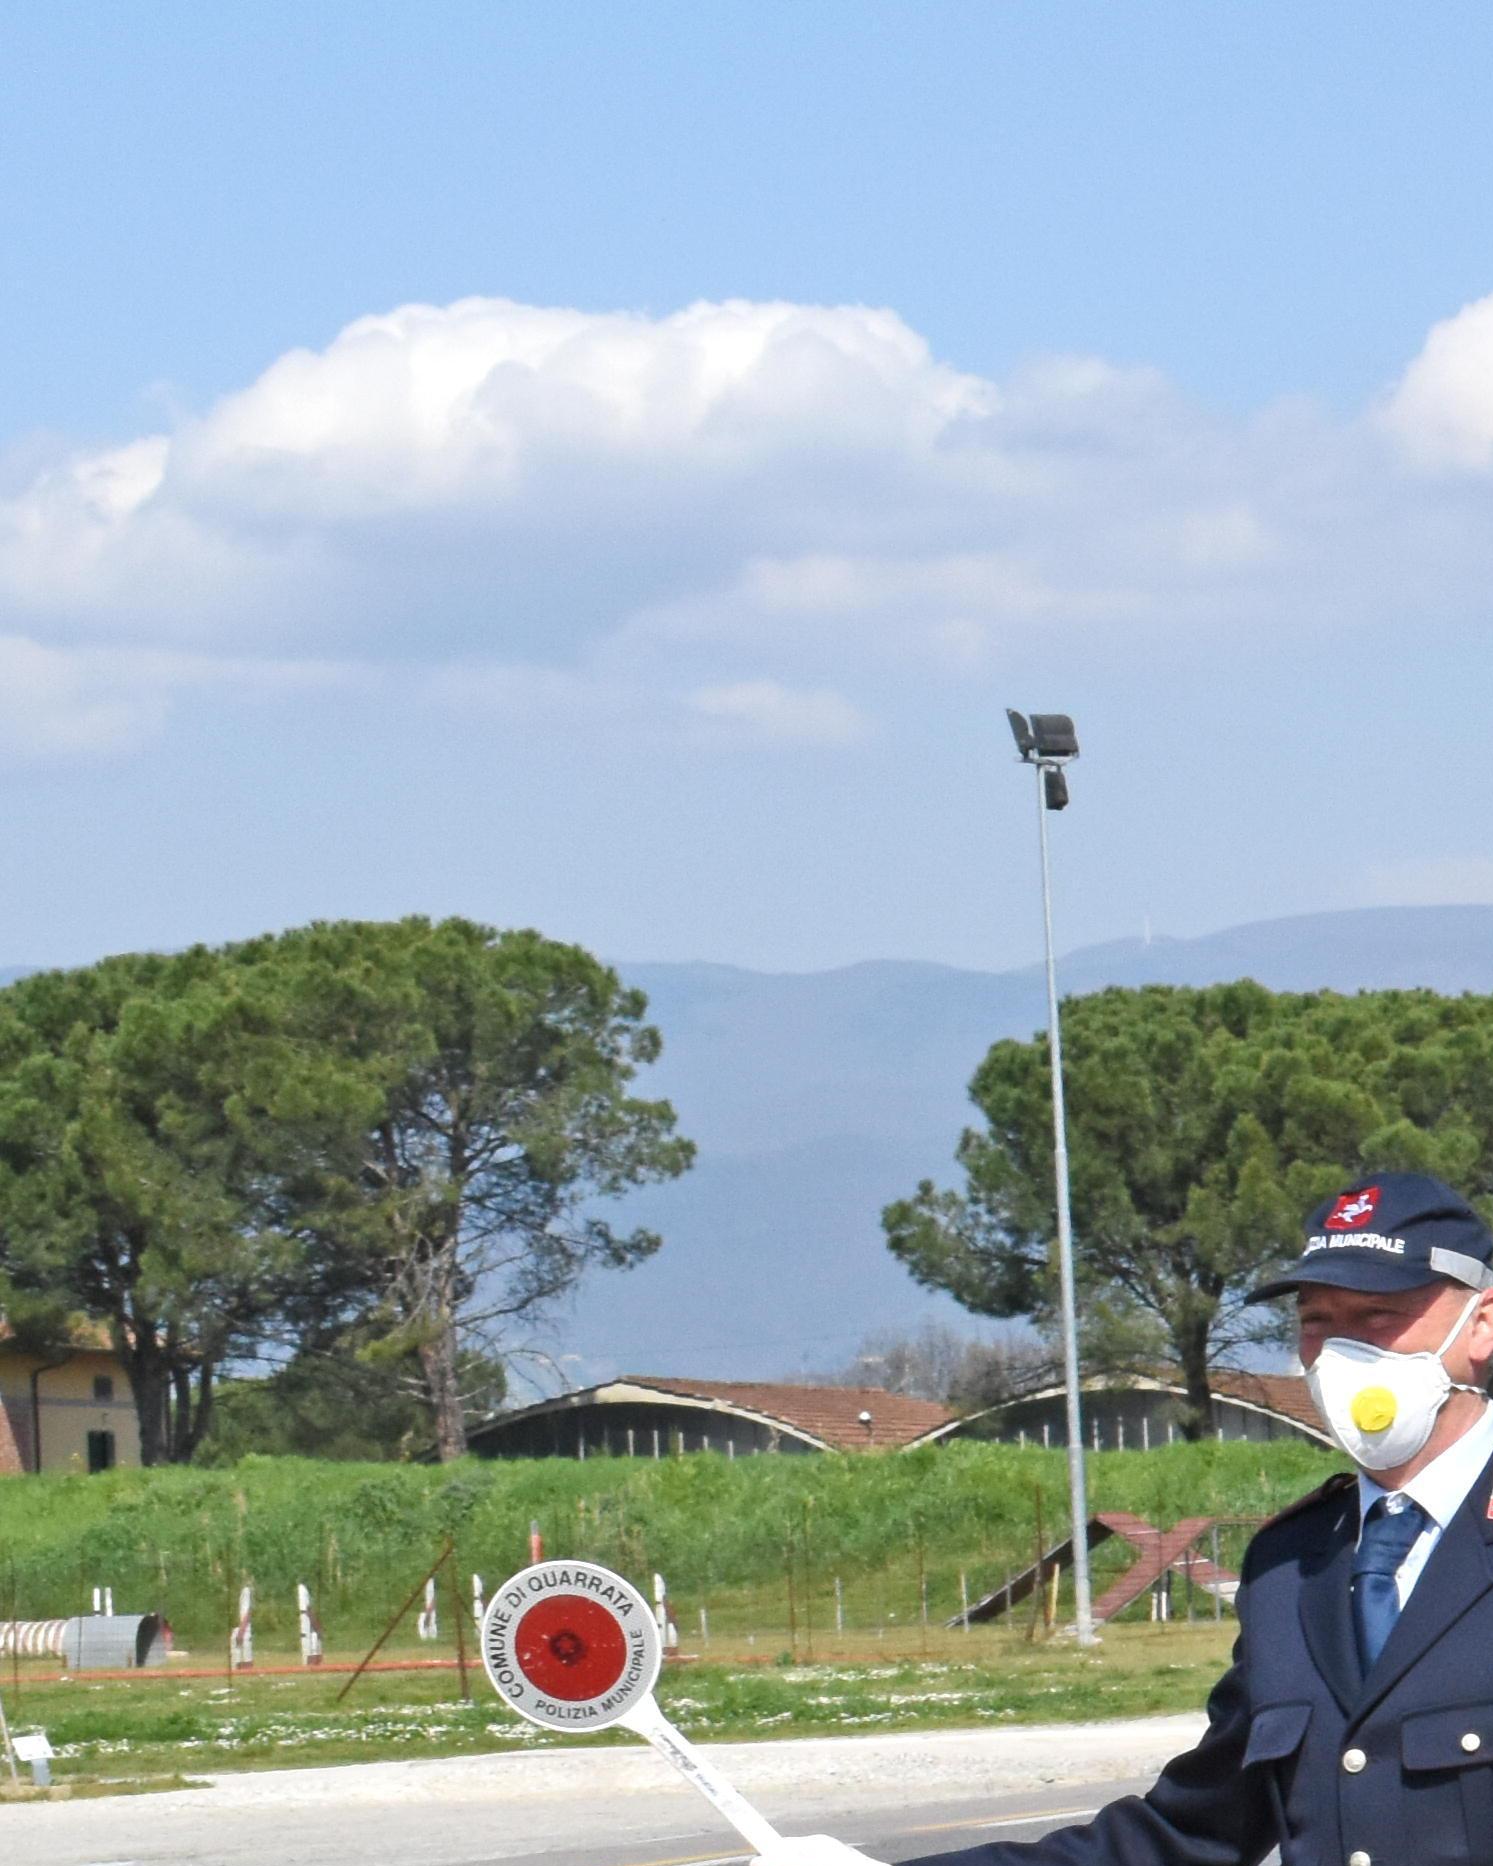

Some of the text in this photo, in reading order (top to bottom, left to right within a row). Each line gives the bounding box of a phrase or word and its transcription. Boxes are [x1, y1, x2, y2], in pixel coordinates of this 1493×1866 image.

[1329, 1233, 1406, 1254] MUNICIPALE
[487, 1571, 635, 1700] COMUNE DI QUARRATA
[535, 1629, 646, 1720] POLIZIA MUNICIPALE
